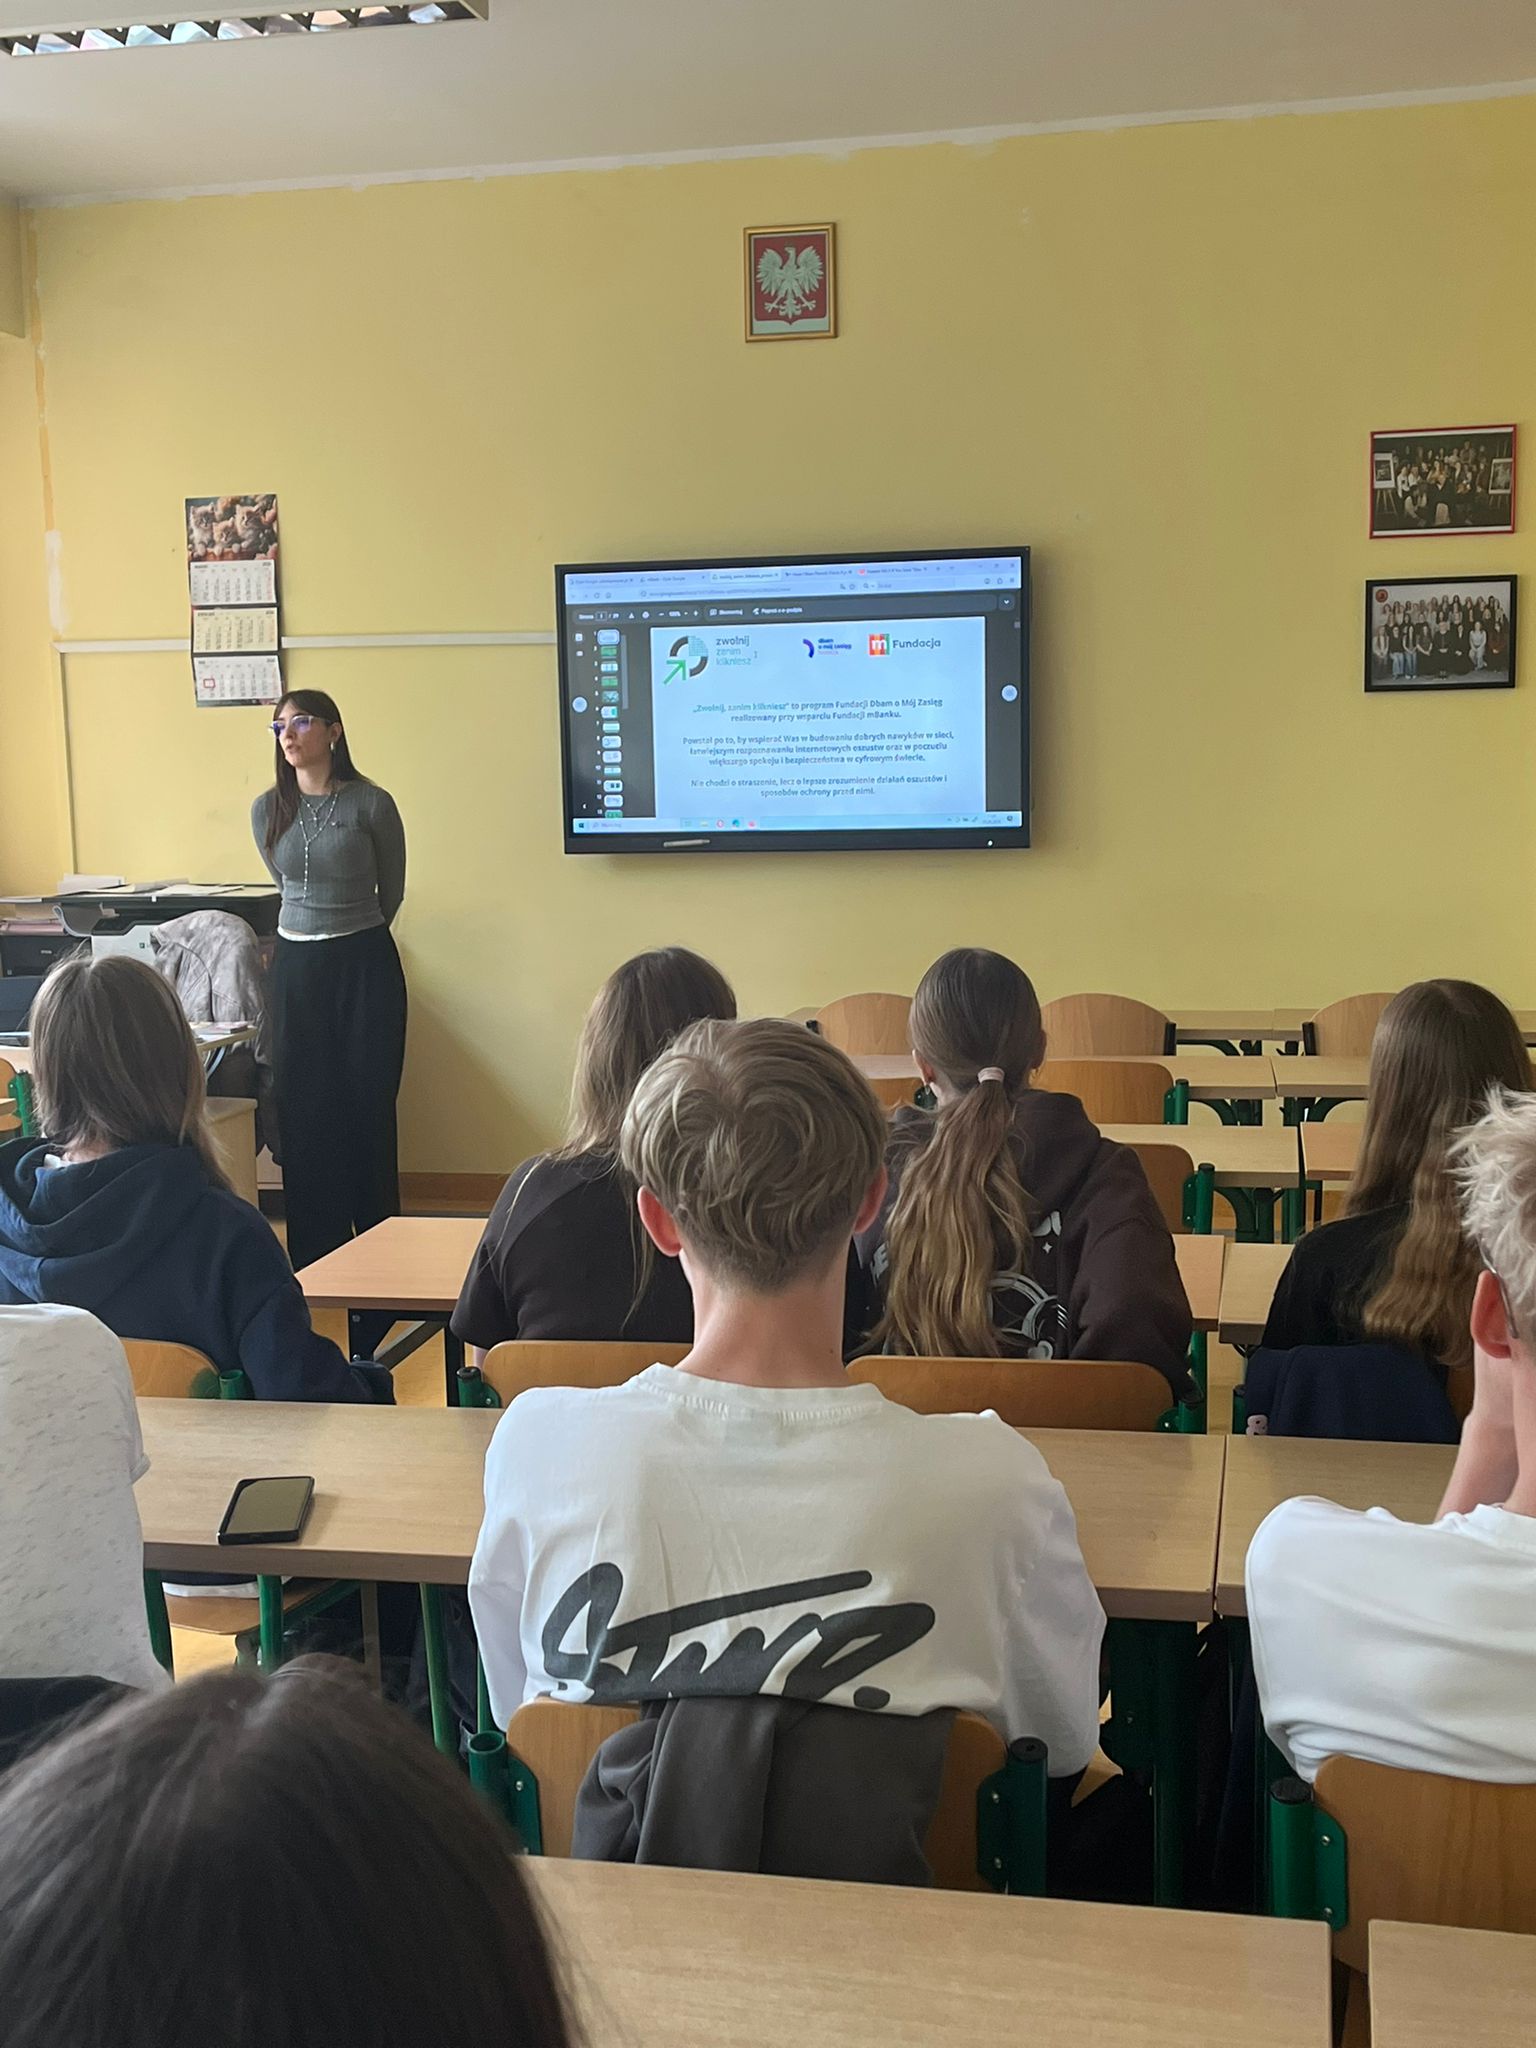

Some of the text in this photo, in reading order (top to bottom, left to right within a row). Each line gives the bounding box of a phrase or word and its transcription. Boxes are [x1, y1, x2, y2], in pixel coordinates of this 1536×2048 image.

[716, 635, 750, 647] zwolnij
[892, 638, 942, 649] Fundacja
[800, 702, 834, 711] program
[835, 701, 868, 710] Fundacji
[870, 700, 893, 708] Dbam
[901, 699, 916, 708] Mój
[917, 698, 943, 708] Zasięg
[731, 710, 902, 723] realizowany przy wsparciu Fundacji mBanku.
[682, 736, 713, 745] Powstał
[714, 738, 724, 746] po
[737, 736, 747, 745] by
[748, 735, 782, 745] wspierać
[783, 735, 801, 743] Was
[809, 733, 853, 742] budowaniu
[854, 732, 886, 742] dobrych
[887, 732, 925, 742] nawyków
[690, 746, 735, 756] łatwiejszym
[736, 745, 794, 755] rozpoznawaniu
[795, 744, 852, 754] internetowych
[853, 744, 885, 752] oszustw
[886, 743, 903, 751] oraz
[913, 742, 947, 752] poczuciu
[709, 757, 749, 767] większego
[749, 757, 779, 766] spokoju
[784, 755, 846, 764] bezpieczeństwa
[846, 755, 854, 763] w
[855, 754, 894, 764] cyfrowym
[691, 779, 705, 788] Nie
[705, 779, 730, 787] chodzi
[737, 778, 779, 787] straszenie,
[780, 778, 795, 786] lecz
[802, 777, 828, 787] lepsze
[828, 776, 876, 785] zrozumienie
[876, 774, 905, 784] działań
[906, 773, 943, 783] oszustów
[760, 788, 799, 798] sposobów
[800, 786, 831, 797] ochrony
[832, 785, 855, 797] przed
